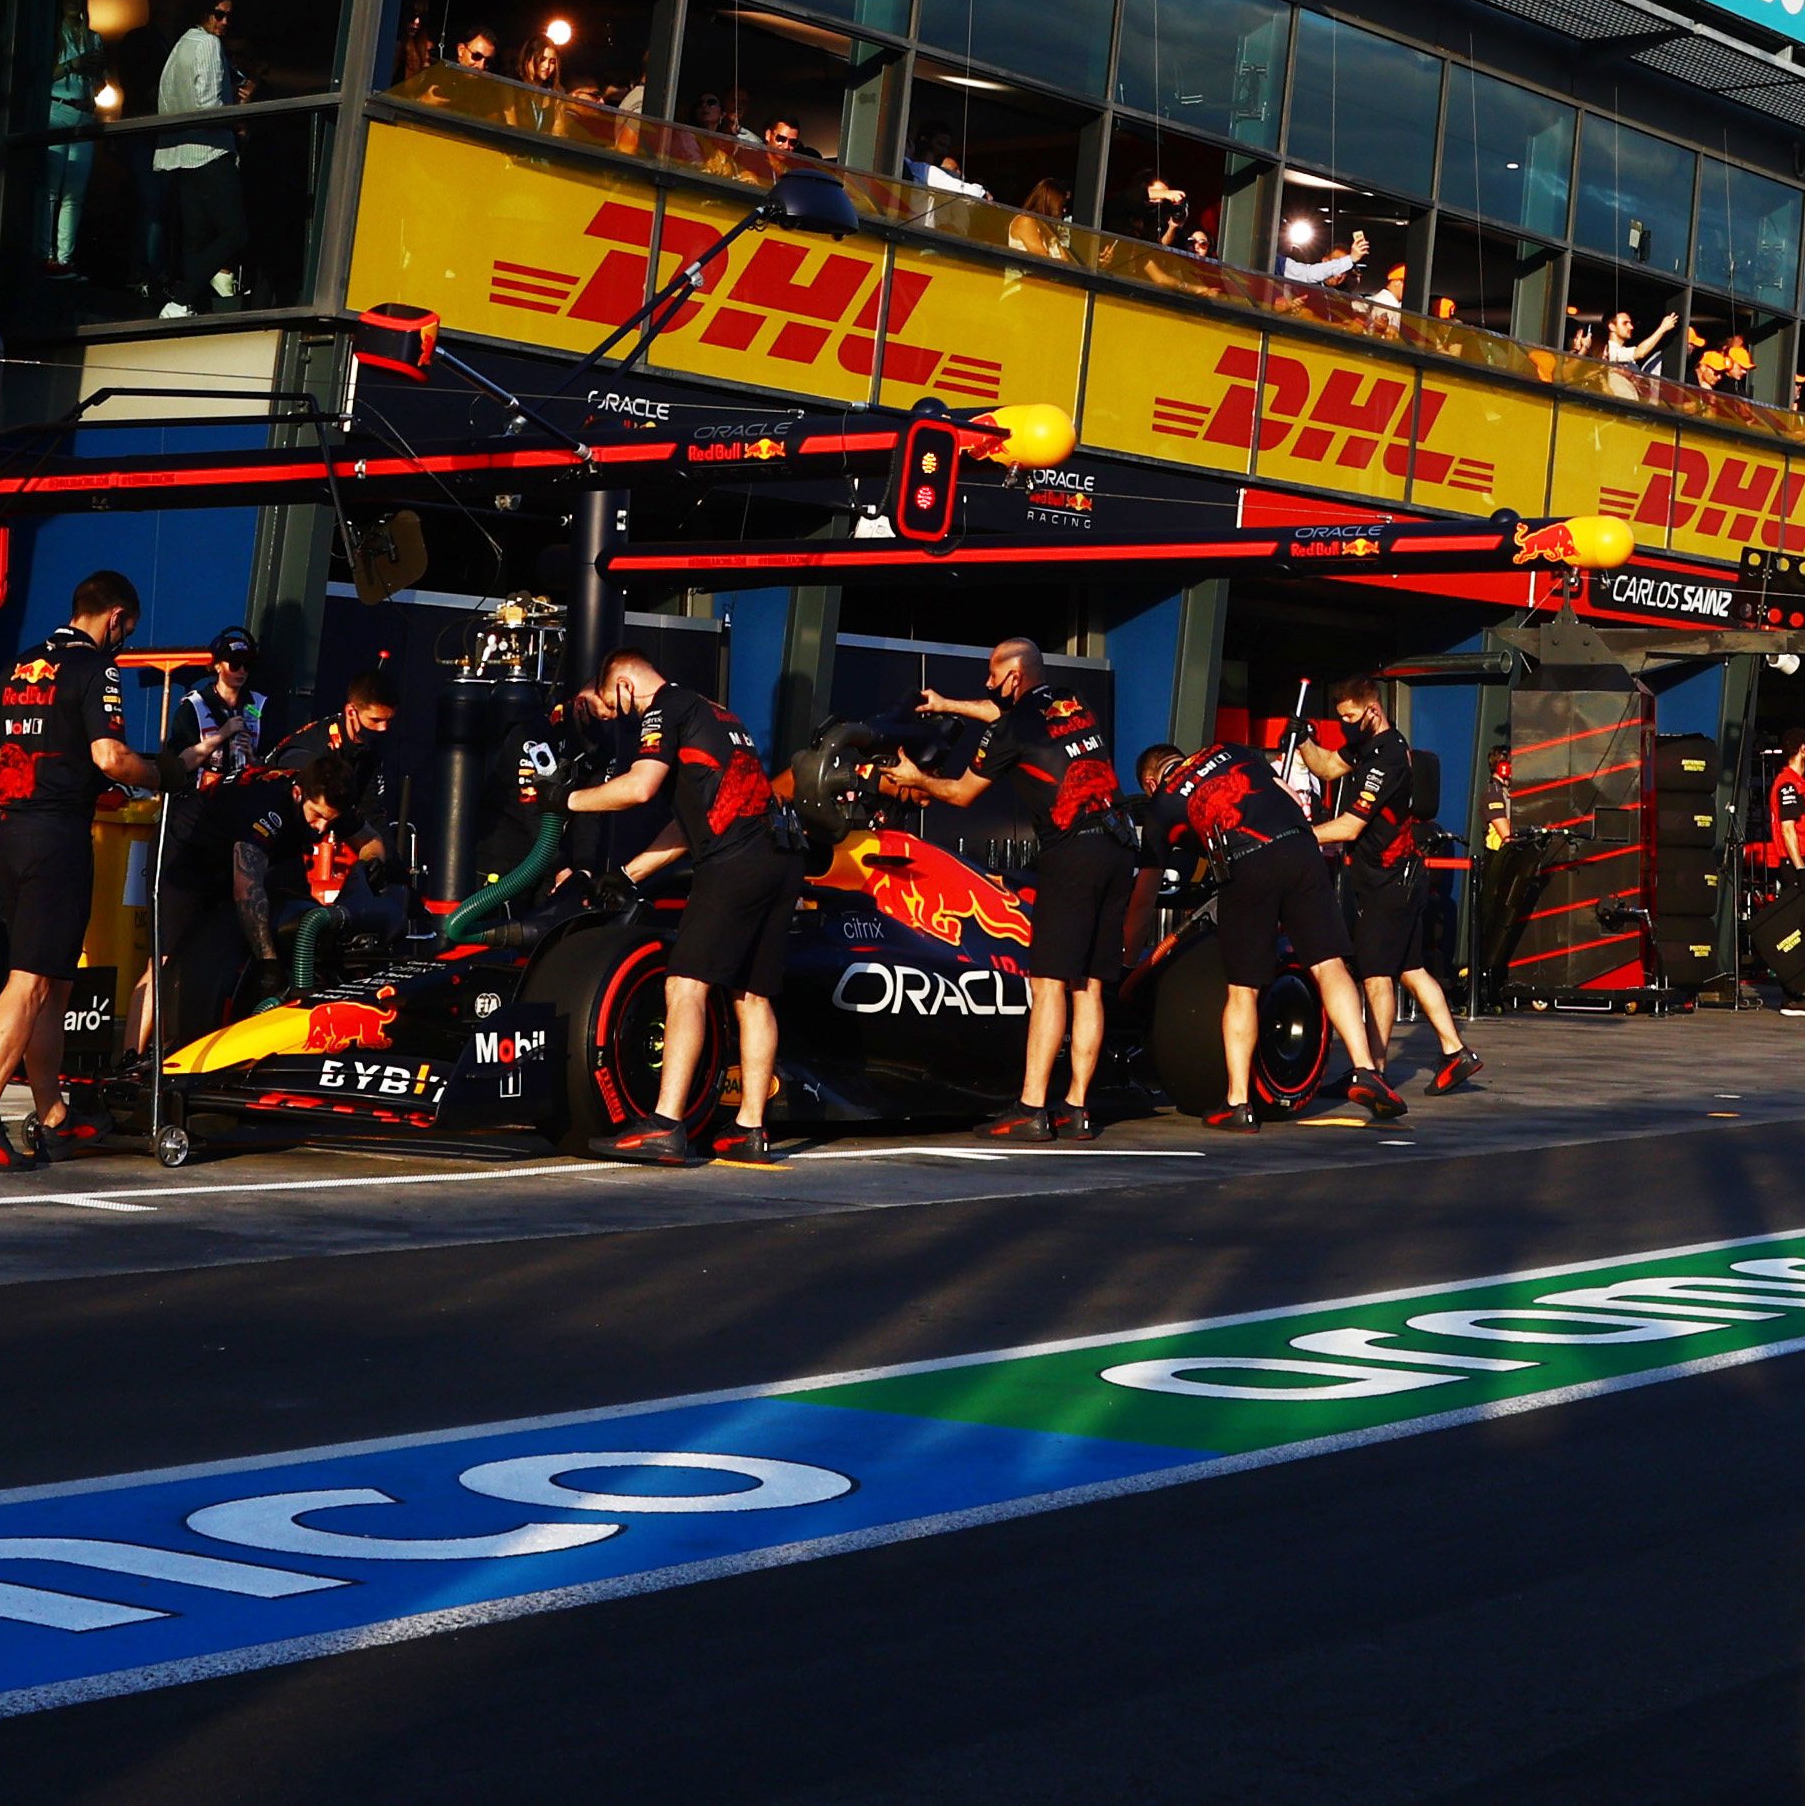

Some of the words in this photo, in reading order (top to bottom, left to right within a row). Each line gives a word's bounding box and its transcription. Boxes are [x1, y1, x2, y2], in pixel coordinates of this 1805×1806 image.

[568, 201, 942, 386] DHL
[587, 391, 670, 420] ORACLE
[1203, 344, 1456, 486] DHL
[693, 422, 793, 440] ORACLE
[688, 443, 715, 462] Red
[715, 441, 742, 461] Bull
[1033, 468, 1095, 492] ORACLE
[1026, 511, 1092, 529] RACING
[1295, 525, 1386, 540] ORACLE
[1290, 543, 1315, 558] Red
[1315, 541, 1341, 557] Bull
[1612, 575, 1683, 610] CARLOS
[1680, 587, 1733, 618] SAINZ
[1065, 735, 1099, 758] Mobil
[843, 916, 885, 940] citrix
[831, 961, 1031, 1016] ORACL
[475, 993, 501, 1018] FIA
[63, 1006, 100, 1032] aro
[475, 1031, 545, 1064] Mobil
[500, 1069, 521, 1098] 1
